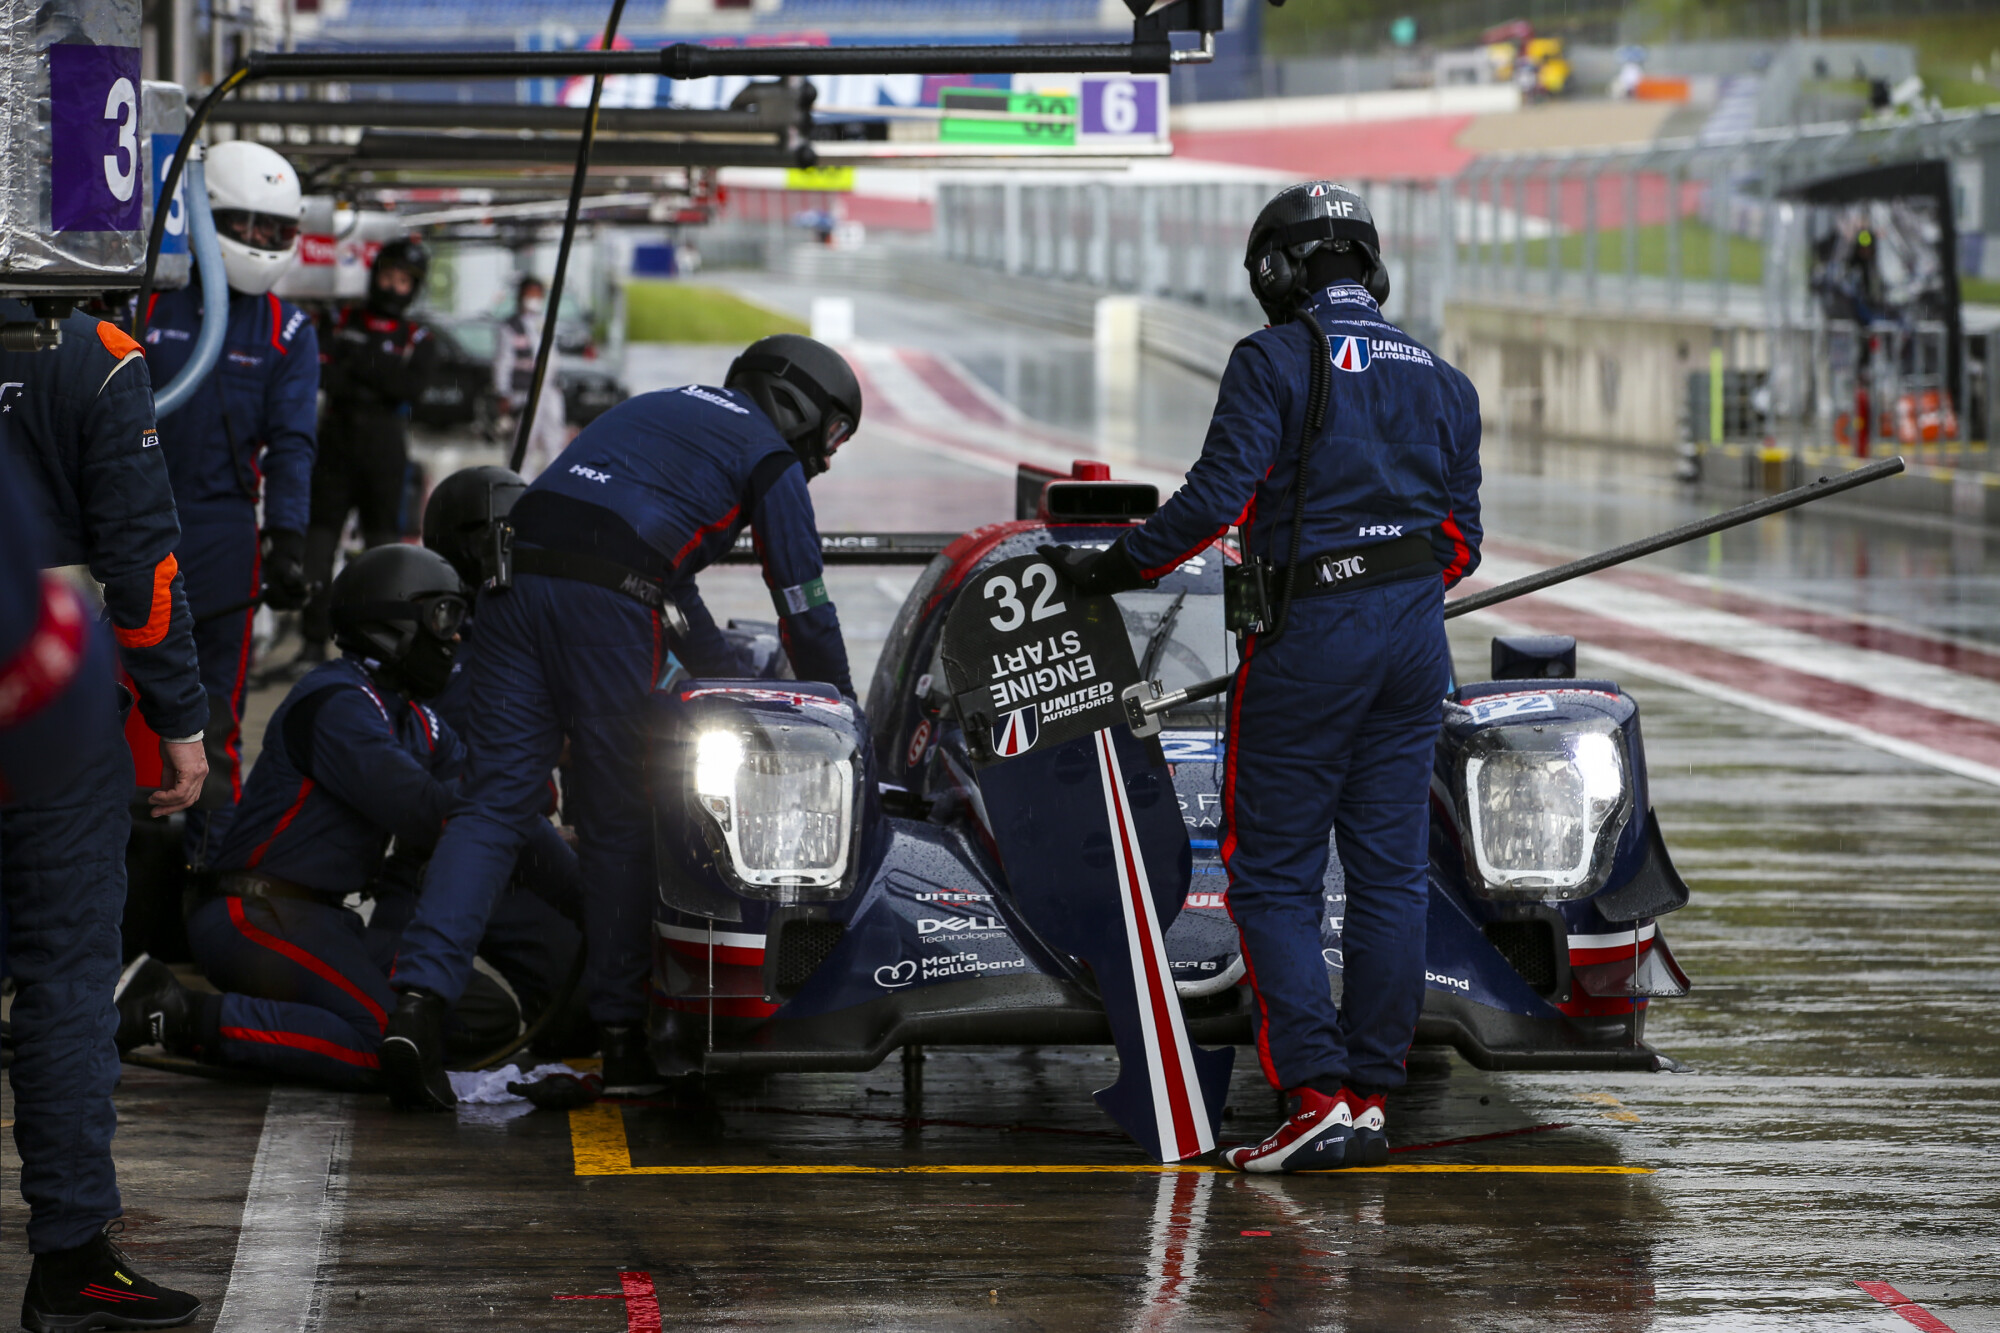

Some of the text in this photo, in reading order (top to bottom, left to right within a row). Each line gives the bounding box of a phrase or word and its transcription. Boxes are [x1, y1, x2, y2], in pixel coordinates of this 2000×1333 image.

[1103, 79, 1139, 133] 6
[104, 77, 137, 202] 3
[1325, 200, 1354, 218] HF
[1371, 339, 1432, 360] UNITED
[1371, 351, 1434, 368] AUTOSPORTS
[569, 464, 612, 484] HRX
[1358, 525, 1404, 537] HRX
[983, 563, 1067, 632] 32
[991, 630, 1082, 680] START
[989, 654, 1097, 708] ENGINE
[1040, 681, 1114, 714] UNITED
[1474, 696, 1549, 719] P2
[1041, 694, 1115, 725] AUTOSPORTS
[915, 892, 995, 902] UITERT
[1186, 894, 1225, 908] UL
[916, 916, 1007, 935] DELL
[918, 931, 1008, 944] Technologies
[922, 951, 978, 968] Maria
[922, 957, 1026, 980] Mallaband
[1425, 969, 1470, 991] band
